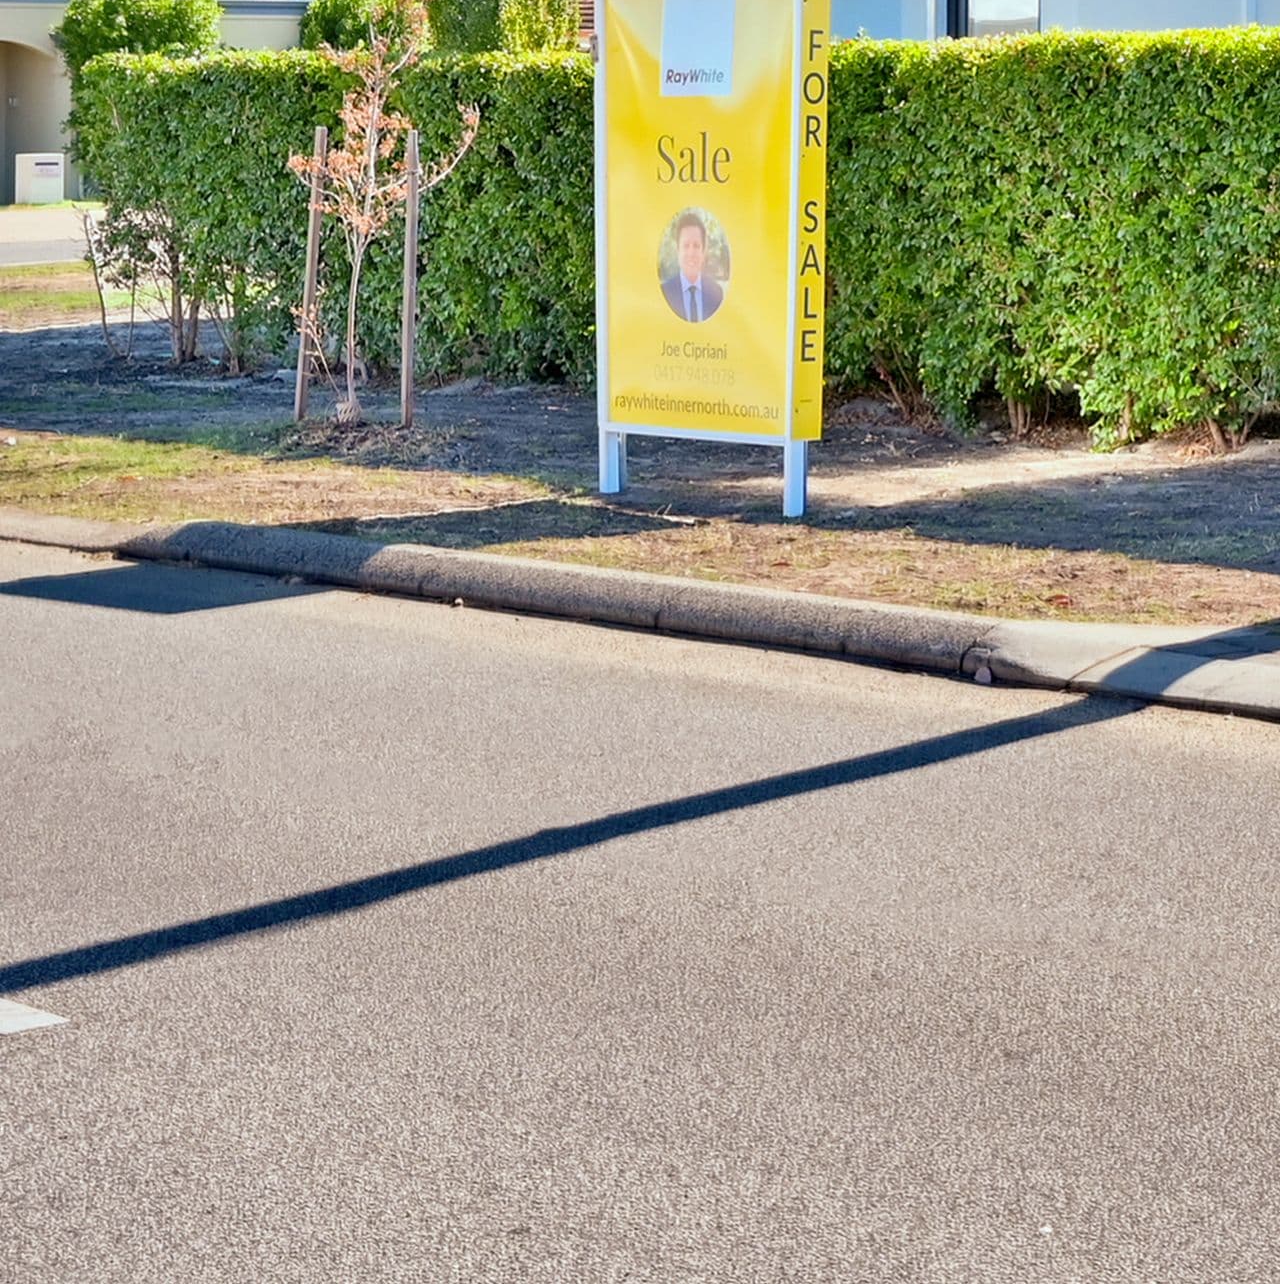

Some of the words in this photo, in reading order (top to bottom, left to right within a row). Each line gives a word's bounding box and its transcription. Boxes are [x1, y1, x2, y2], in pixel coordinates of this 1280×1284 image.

[803, 29, 825, 147] FOR
[657, 131, 730, 184] Sale
[800, 200, 821, 362] SALE
[661, 341, 680, 357] Joe
[683, 342, 727, 360] Cipriani
[614, 393, 779, 420] raywhiteinnernorth.com.au
